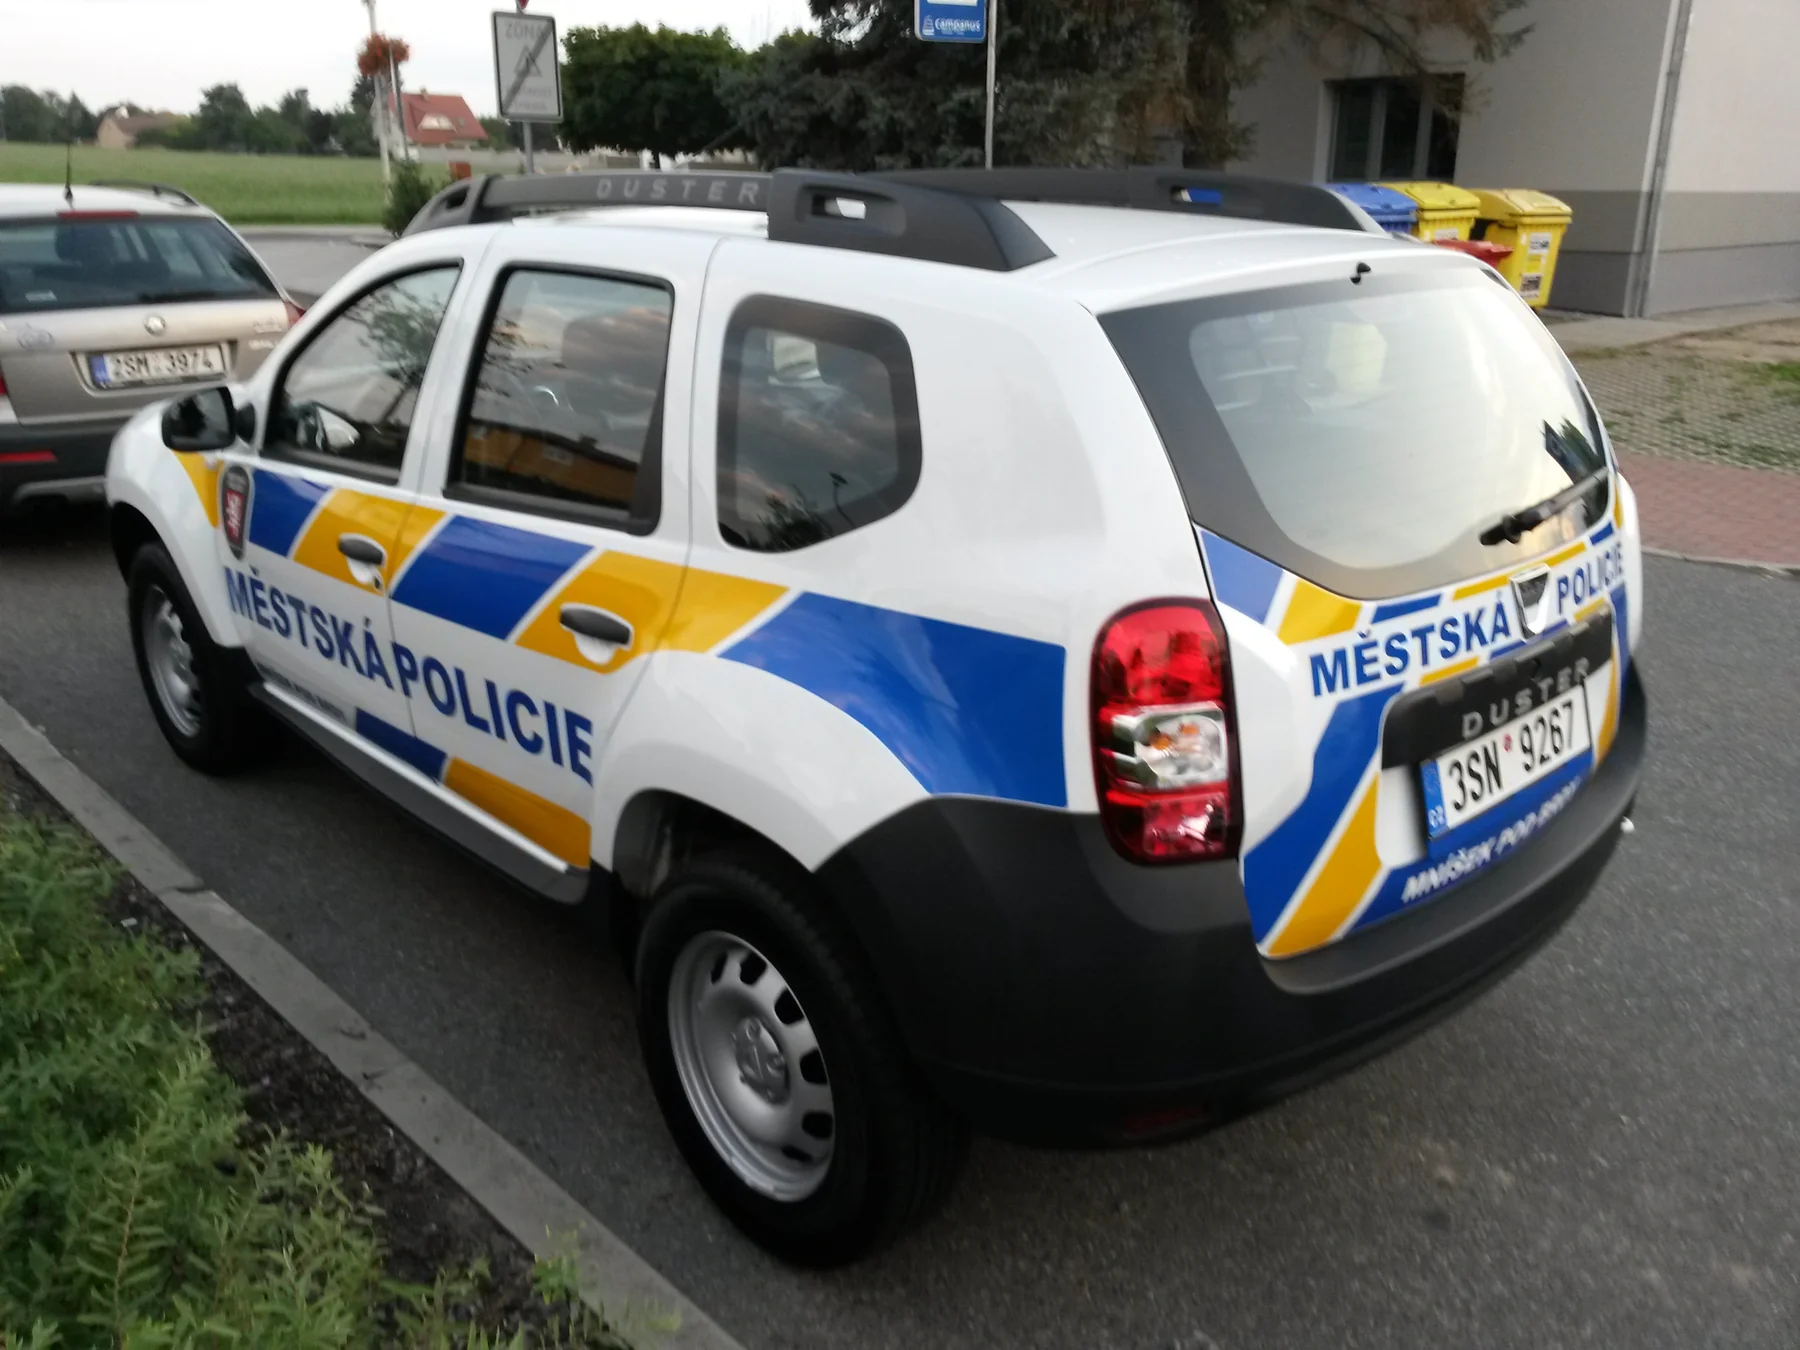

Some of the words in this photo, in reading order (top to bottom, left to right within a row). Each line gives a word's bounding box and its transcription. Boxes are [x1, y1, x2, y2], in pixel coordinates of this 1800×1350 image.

[596, 178, 760, 205] DUSTER
[1310, 591, 1511, 698] MĚSTSKÁ
[1557, 541, 1623, 615] POLICIE
[224, 565, 395, 692] MĚSTSKÁ
[391, 641, 594, 788] POLICIE
[1461, 657, 1590, 741] DUSTER
[1449, 740, 1503, 811] 3SN
[1520, 698, 1574, 773] 9267
